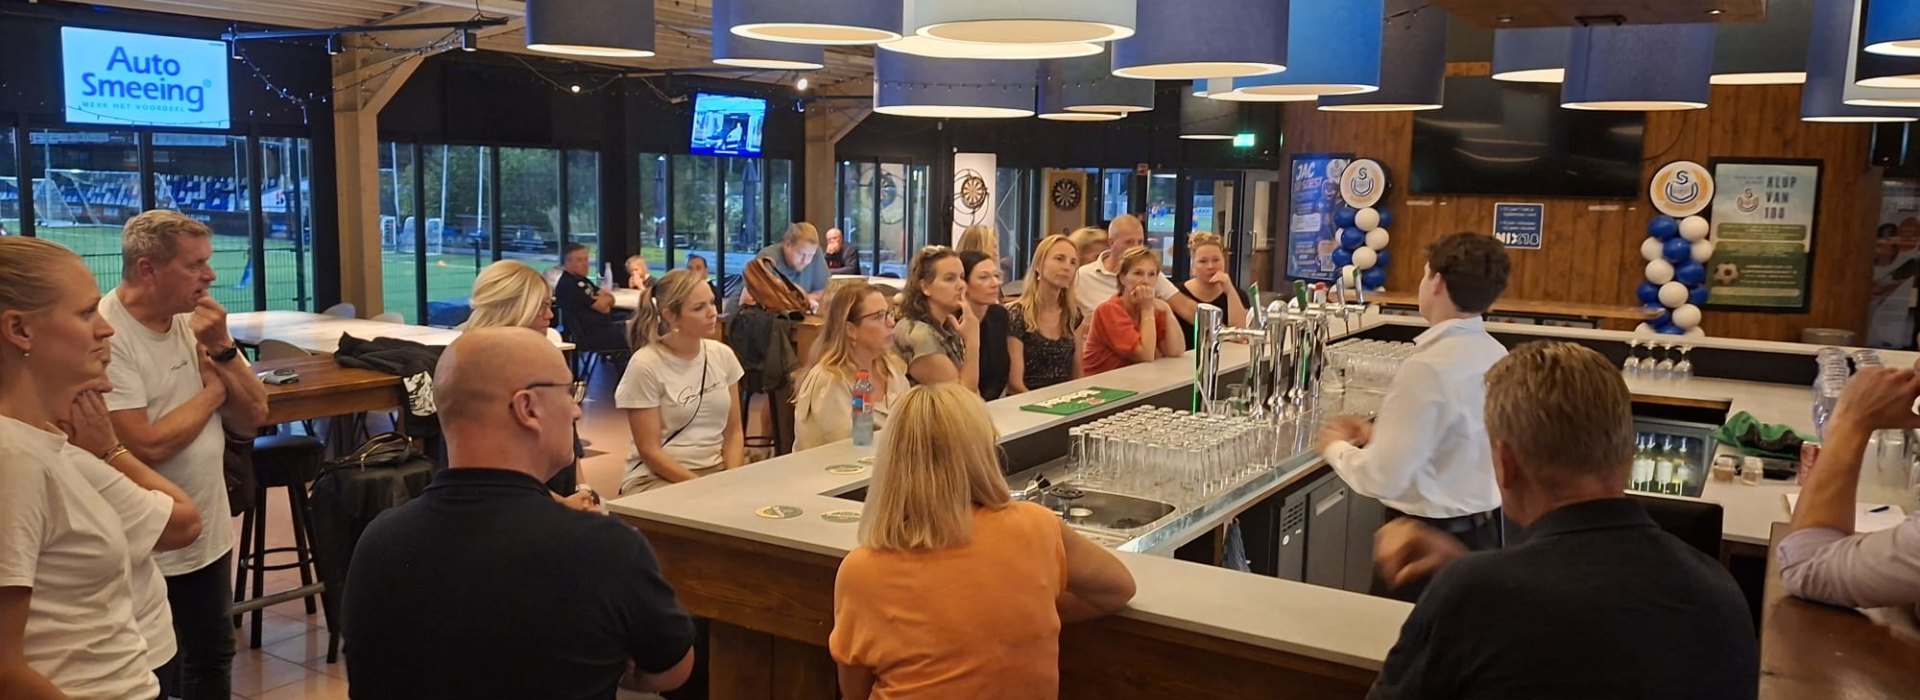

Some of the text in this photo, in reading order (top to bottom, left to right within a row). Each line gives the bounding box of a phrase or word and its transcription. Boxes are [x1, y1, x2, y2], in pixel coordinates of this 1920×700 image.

[106, 45, 181, 76] Auto
[82, 72, 204, 113] Smeeing
[113, 102, 131, 110] HET
[136, 103, 184, 112] VOORDEEL
[1296, 162, 1316, 181] JAC
[1766, 175, 1798, 189] KLUP
[1765, 191, 1789, 204] VAN
[1764, 207, 1785, 220] 100
